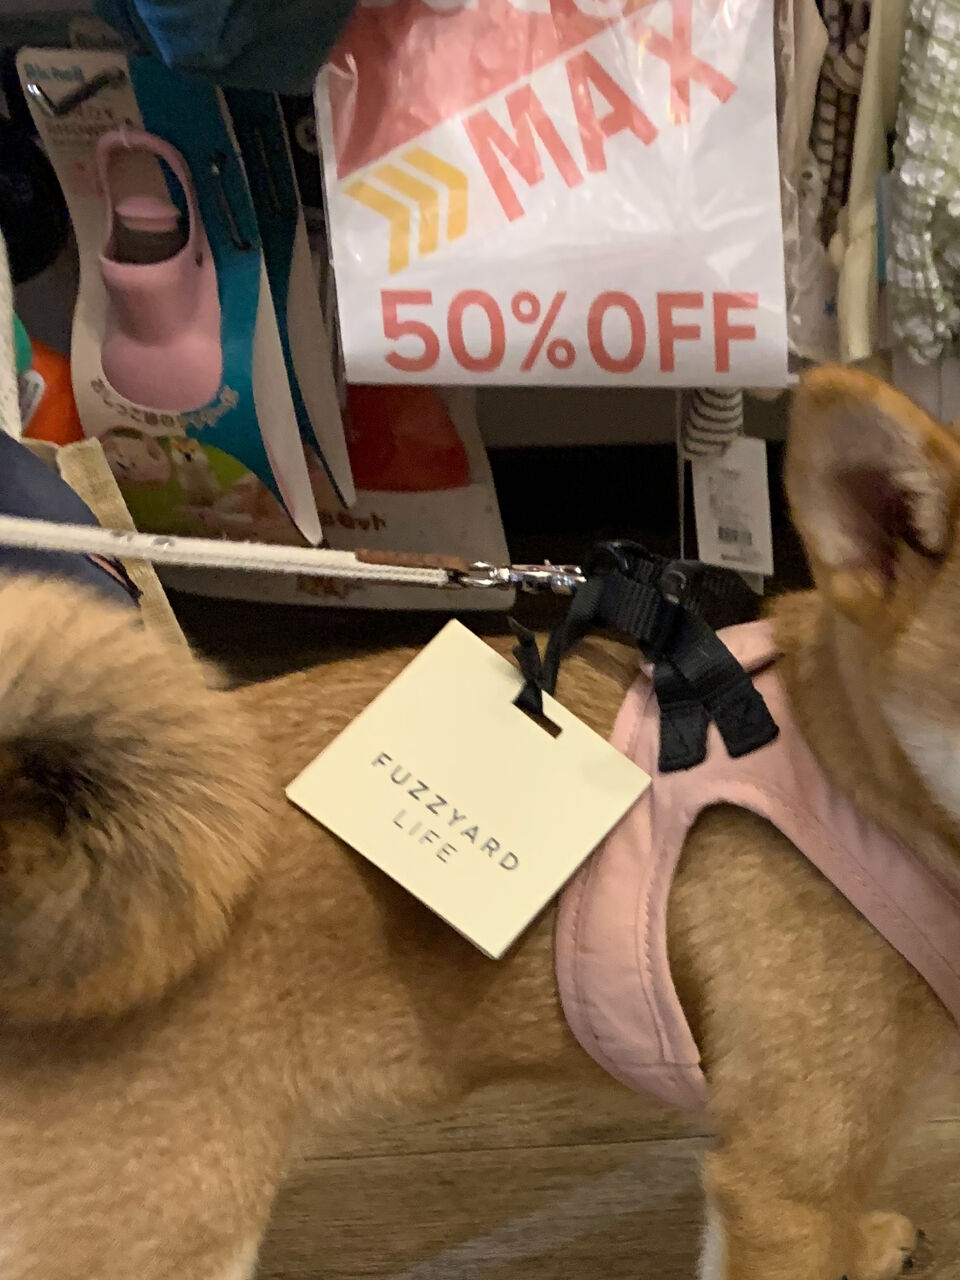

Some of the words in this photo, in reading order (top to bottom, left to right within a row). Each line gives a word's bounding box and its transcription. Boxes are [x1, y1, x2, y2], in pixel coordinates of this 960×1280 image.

[461, 0, 738, 223] MAX
[380, 288, 759, 375] 50%OFF
[371, 751, 520, 871] FUZZYARD
[392, 808, 458, 864] LIFE
